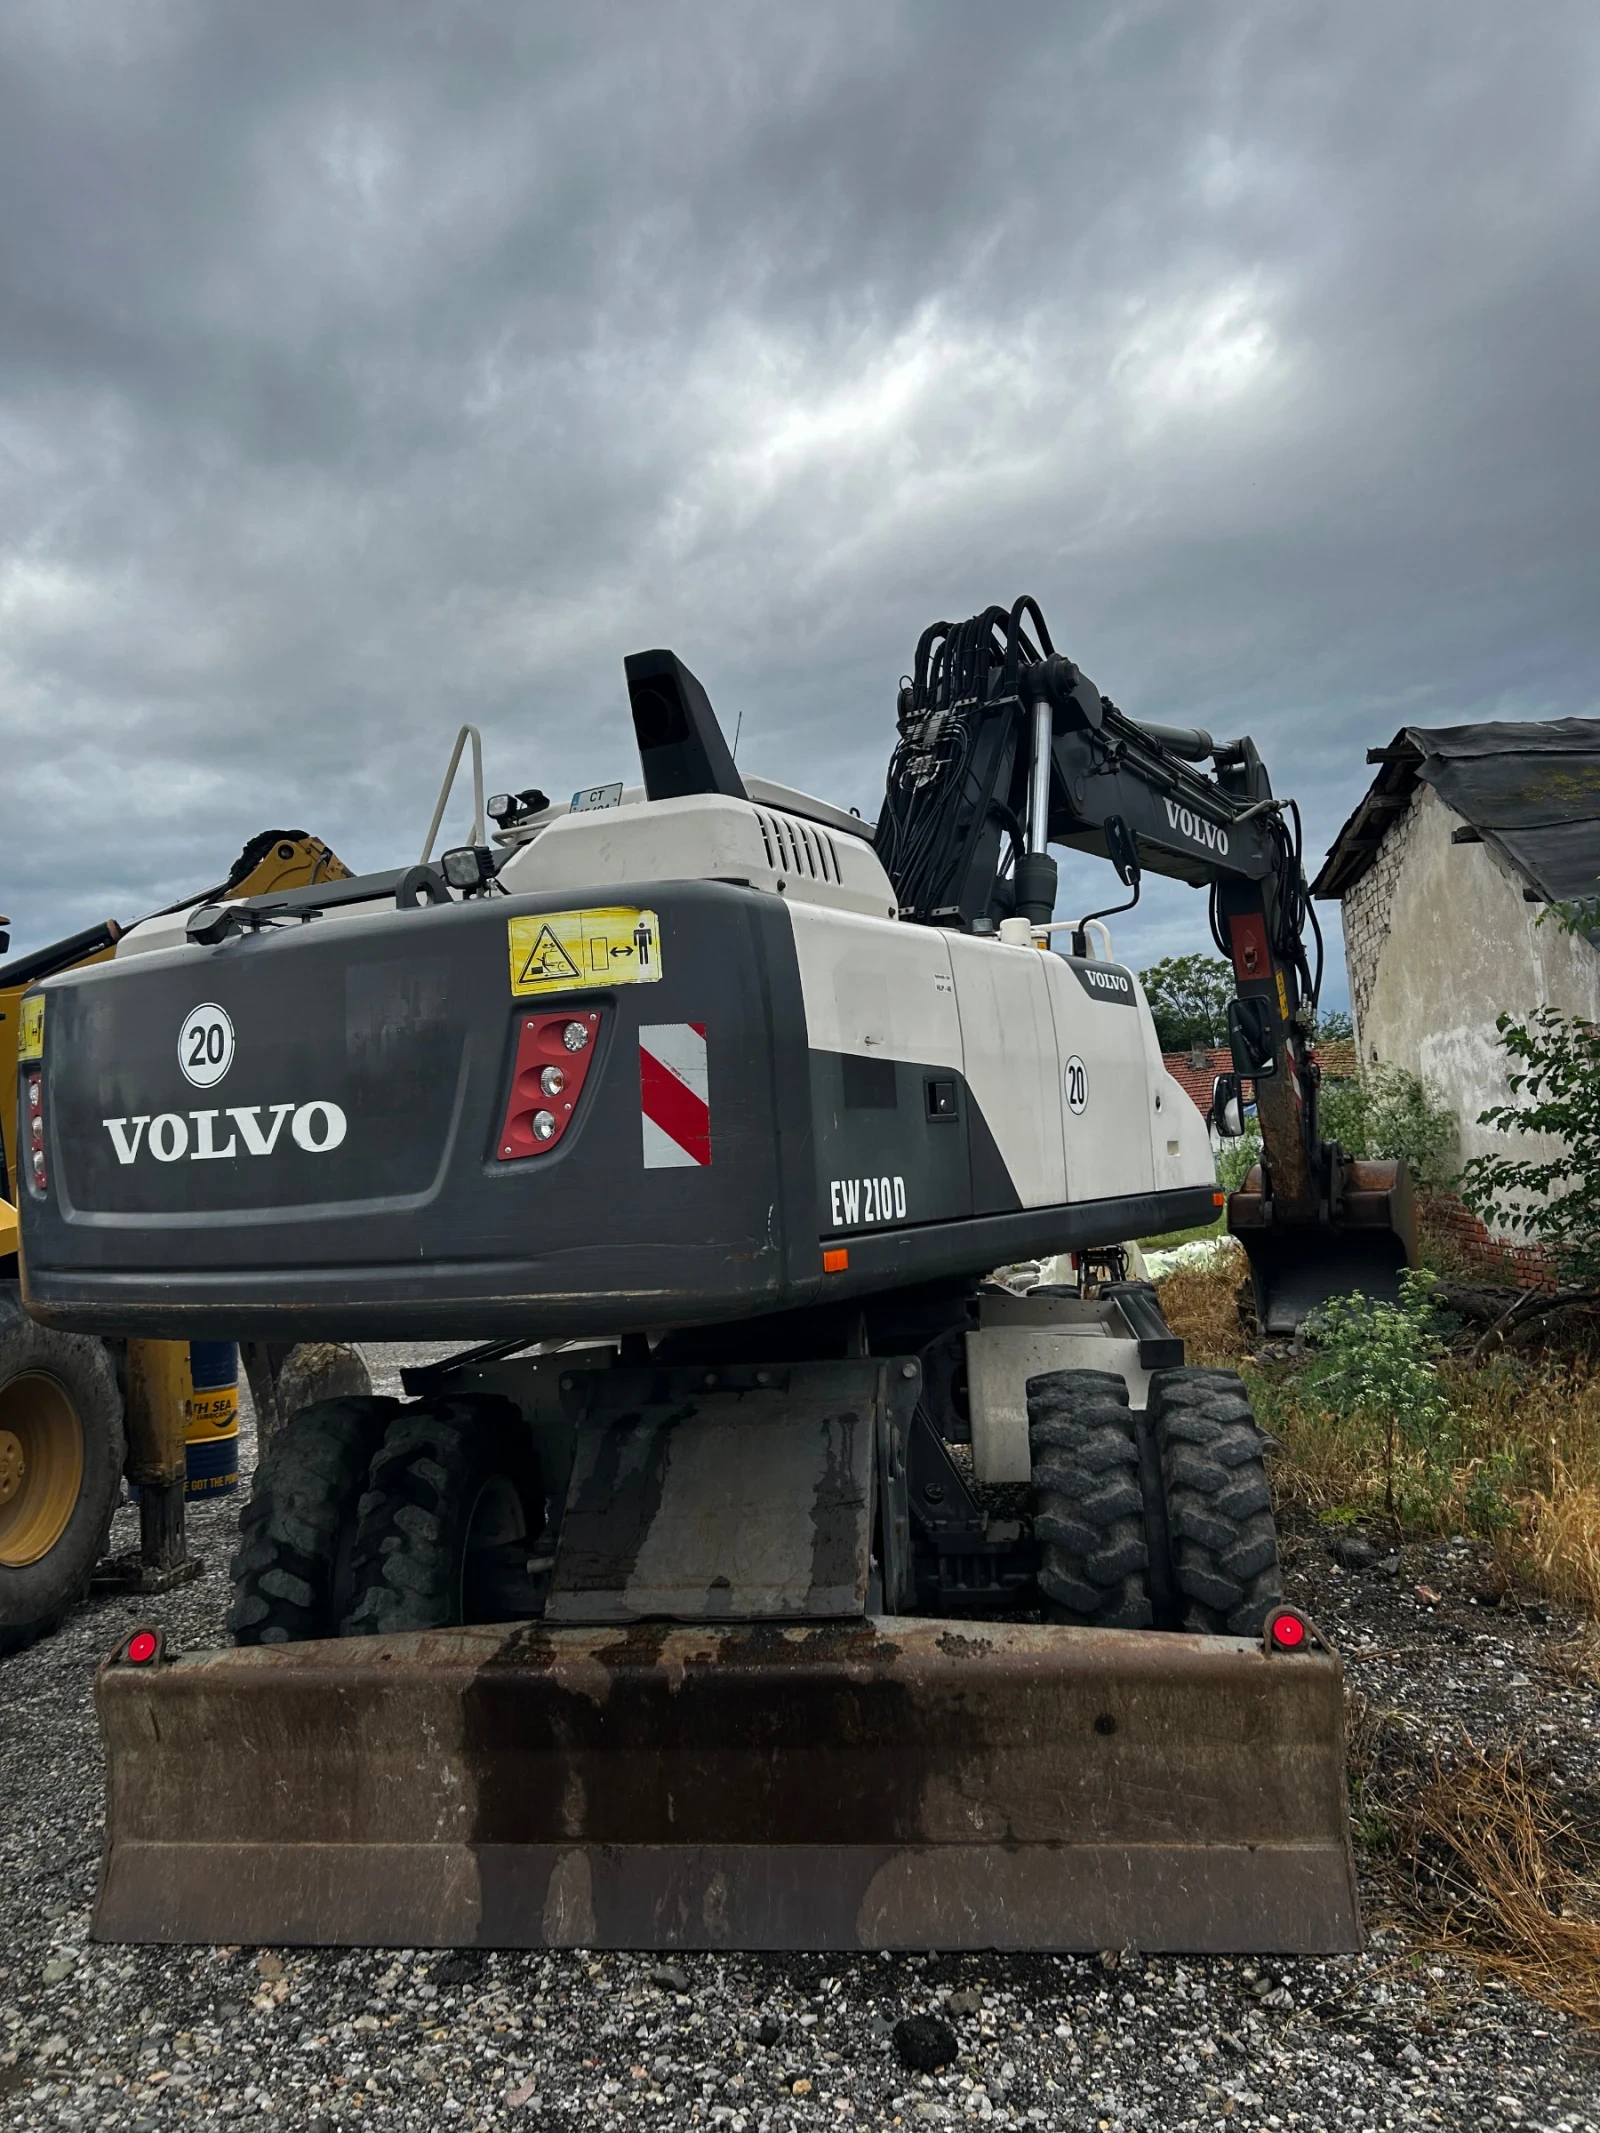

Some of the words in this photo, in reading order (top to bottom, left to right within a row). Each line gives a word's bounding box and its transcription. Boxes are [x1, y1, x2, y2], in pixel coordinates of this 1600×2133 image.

[590, 790, 605, 802] CT
[1163, 797, 1229, 856] VOLVO
[1085, 969, 1128, 992] VOLVO
[188, 1023, 224, 1067] 20
[1068, 1065, 1085, 1105] 20
[102, 1100, 347, 1165] VOLVO
[194, 1403, 208, 1414] TH
[213, 1400, 231, 1411] SEA
[183, 1480, 189, 1492] E
[191, 1479, 208, 1491] GOT
[210, 1476, 224, 1487] THE
